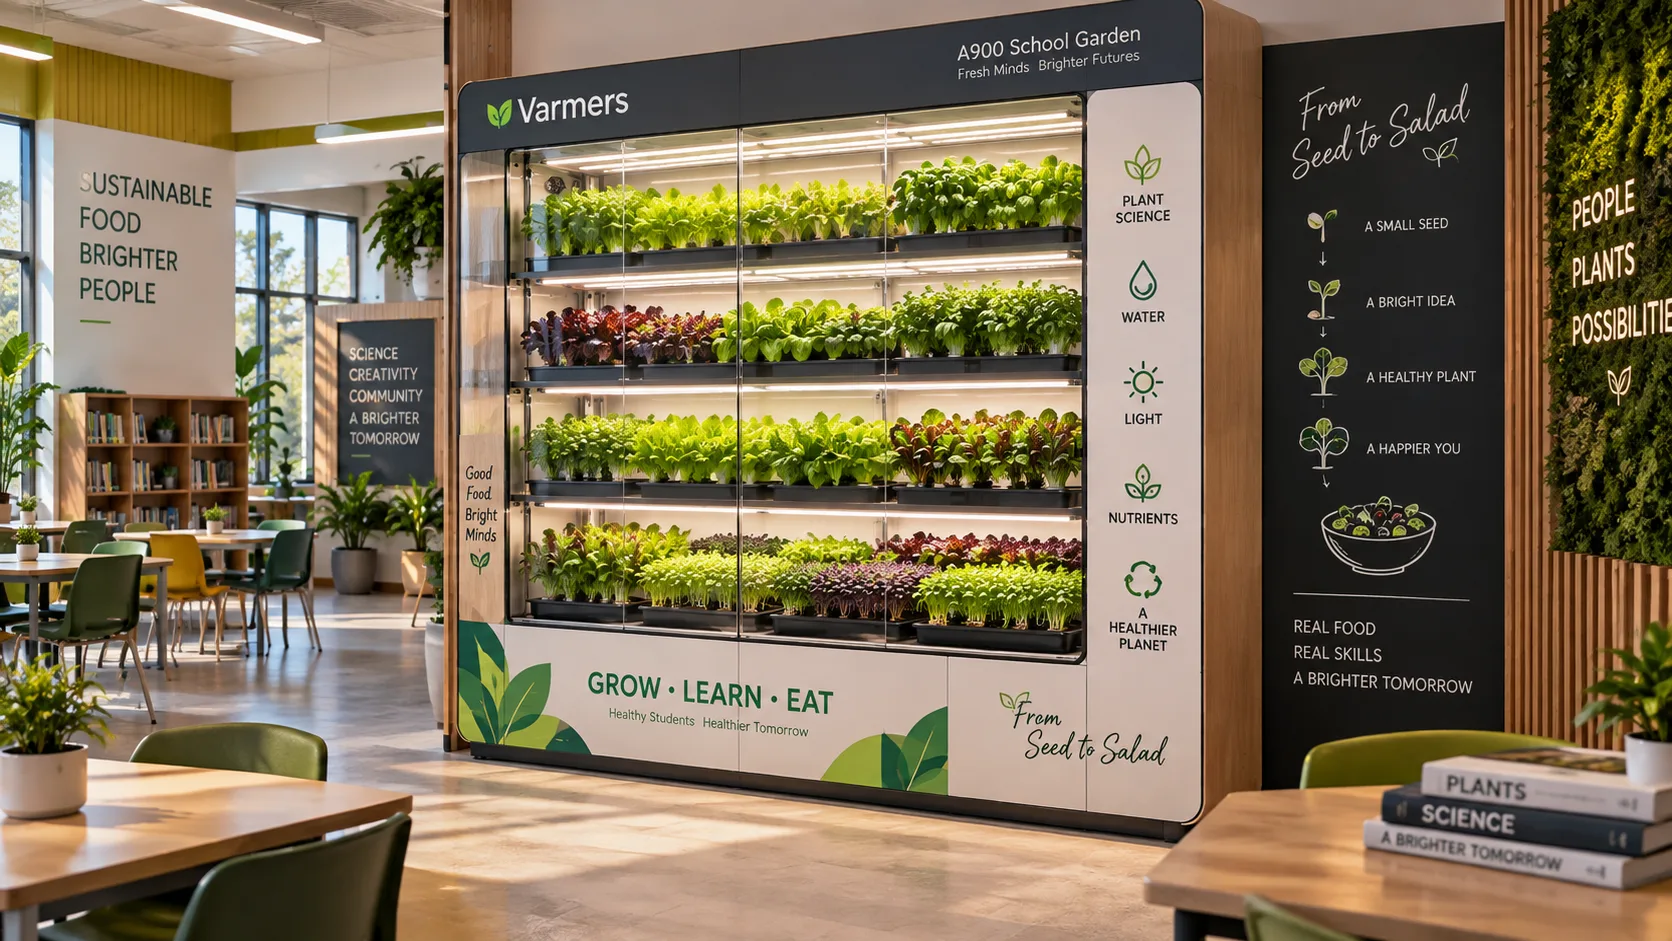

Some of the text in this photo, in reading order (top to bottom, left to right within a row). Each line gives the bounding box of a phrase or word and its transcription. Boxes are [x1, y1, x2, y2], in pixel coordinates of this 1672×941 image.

[957, 26, 1141, 61] A900 School Garden
[957, 51, 1140, 80] Fresh Minds Brighter Futures
[518, 92, 629, 123] Varmers
[1299, 86, 1361, 131] From
[1292, 83, 1471, 180] Seed to Salad
[80, 171, 212, 208] SUSTAINABLE
[1122, 193, 1164, 207] PLANT
[1572, 178, 1635, 231] PEOPLE
[80, 206, 141, 233] FOOD
[1115, 209, 1171, 224] SCIENCE
[1364, 218, 1449, 232] A SMALL SEED
[80, 242, 178, 271] BRIGHTER
[1572, 242, 1635, 288] PLANTS
[80, 277, 156, 304] PEOPLE
[1366, 295, 1456, 308] A BRIGHT IDEA
[1121, 311, 1165, 324] WATER
[349, 347, 398, 361] SCIENCE
[349, 367, 418, 381] CREATIVITY
[1366, 370, 1476, 383] A HEALTHY PLANT
[349, 389, 423, 403] COMMUNITY
[349, 411, 420, 425] A BRIGHTER
[1124, 413, 1163, 425] LIGHT
[350, 432, 420, 445] TOMORROW
[1366, 443, 1461, 455] A HAPPIER YOU
[465, 465, 493, 480] Good
[466, 485, 492, 501] Food
[465, 507, 498, 525] Bright
[1108, 512, 1178, 525] NUTRIENTS
[465, 527, 497, 542] Minds
[1138, 607, 1148, 619] A
[1109, 621, 1178, 637] HEALTHIER
[1293, 619, 1376, 636] REAL FOOD
[1119, 638, 1168, 652] PLANET
[1293, 645, 1382, 663] REAL SKILLS
[1293, 671, 1473, 694] A BRIGHTER TOMORROW
[588, 671, 661, 699] GROW
[683, 680, 762, 709] LEARN
[787, 688, 834, 715] EAT
[609, 708, 809, 737] Healthy Students Healthier Tomorrow
[1025, 728, 1169, 766] Seed to Salad
[1446, 775, 1527, 801] PLANTS
[1421, 804, 1515, 834] SCIENCE
[1380, 831, 1563, 872] A BRIGHTER TOMORROW
